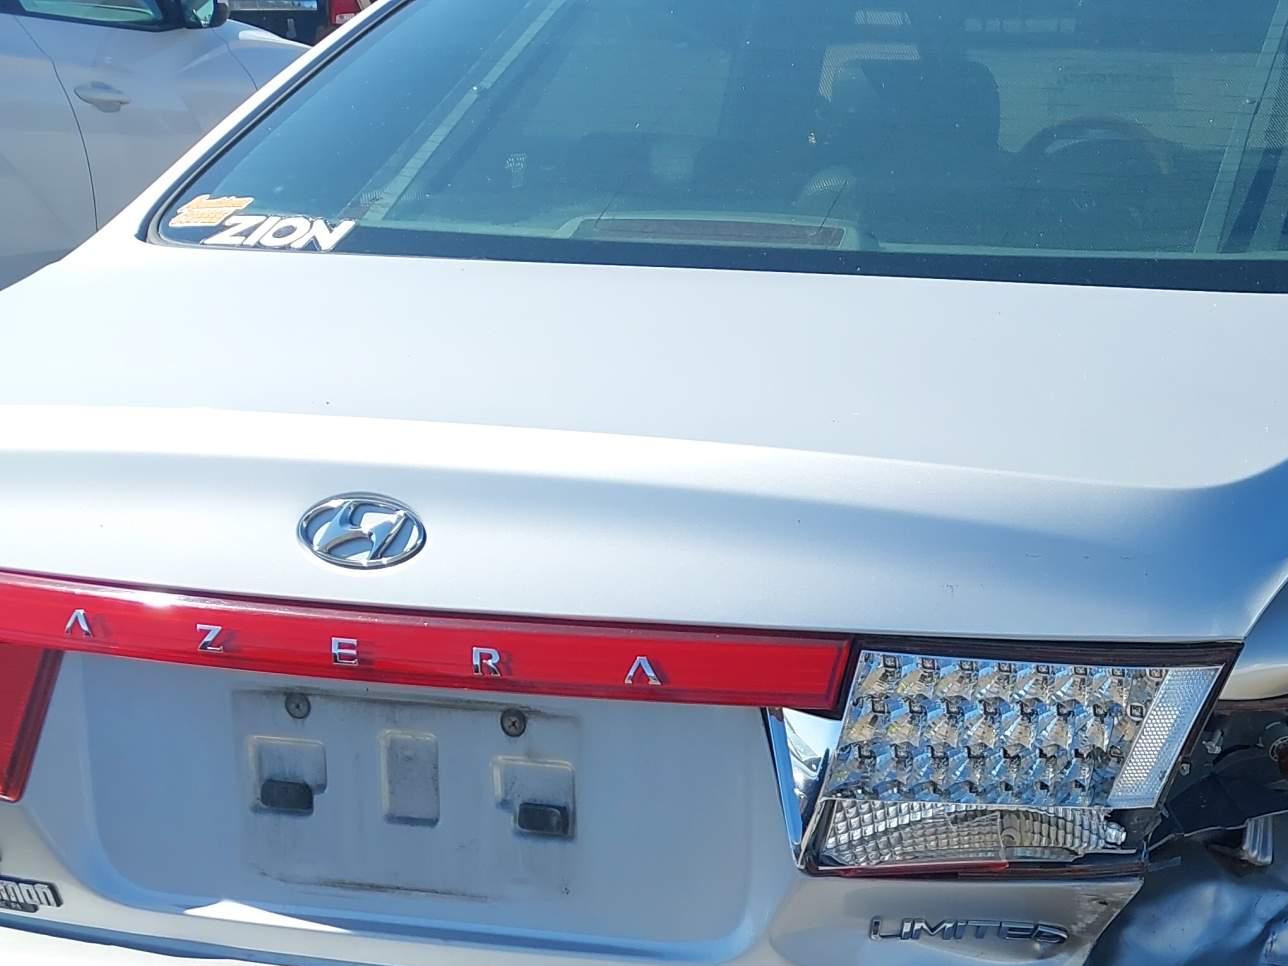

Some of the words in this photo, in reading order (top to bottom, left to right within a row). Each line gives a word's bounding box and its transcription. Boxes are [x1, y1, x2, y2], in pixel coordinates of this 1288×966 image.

[201, 214, 356, 251] ZION
[64, 608, 662, 687] AZERA
[870, 915, 1069, 944] LIMITED
